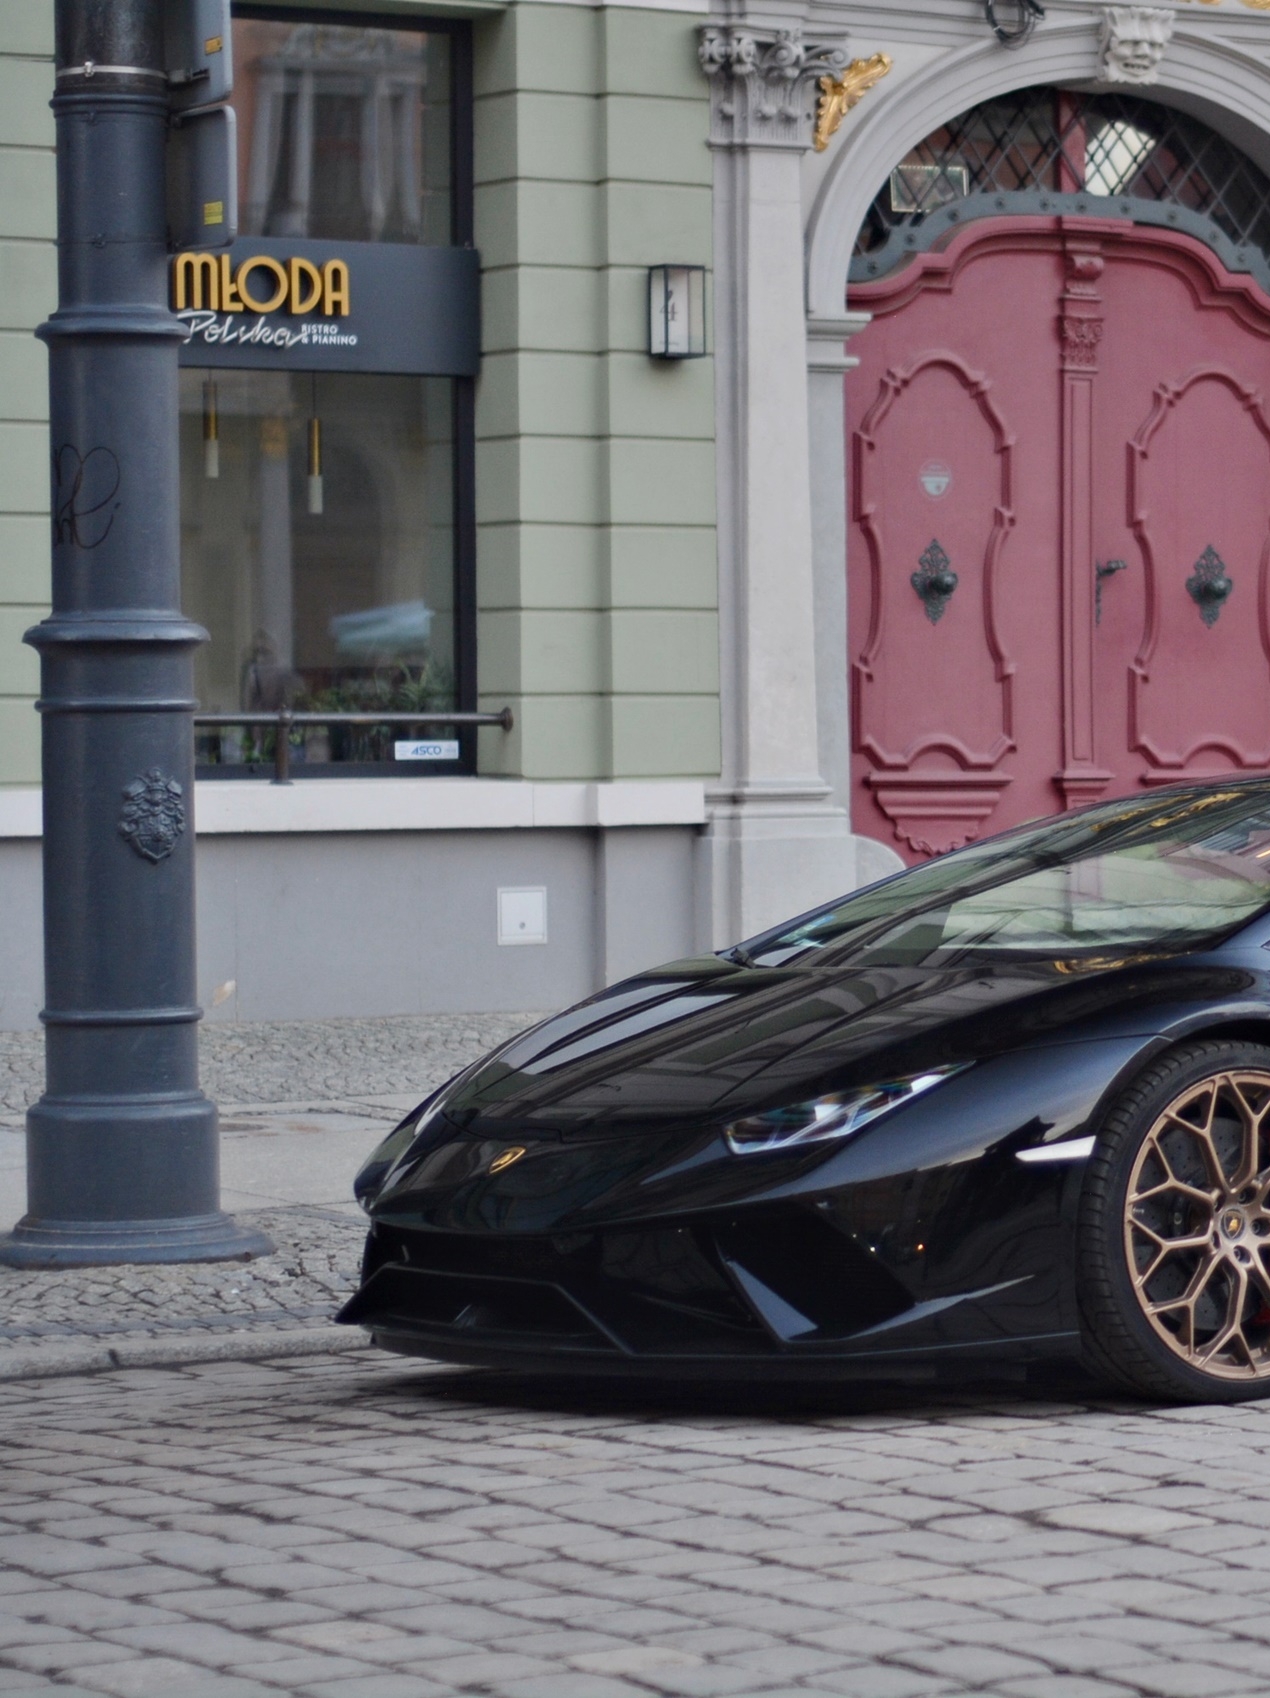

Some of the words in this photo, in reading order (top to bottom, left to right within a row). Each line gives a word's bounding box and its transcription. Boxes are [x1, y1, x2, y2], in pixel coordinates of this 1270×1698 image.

[175, 252, 350, 316] MŁODA
[177, 310, 307, 349] Polska
[301, 324, 339, 335] BISTRO
[312, 334, 358, 346] PIANINO
[411, 746, 441, 756] ASCO
